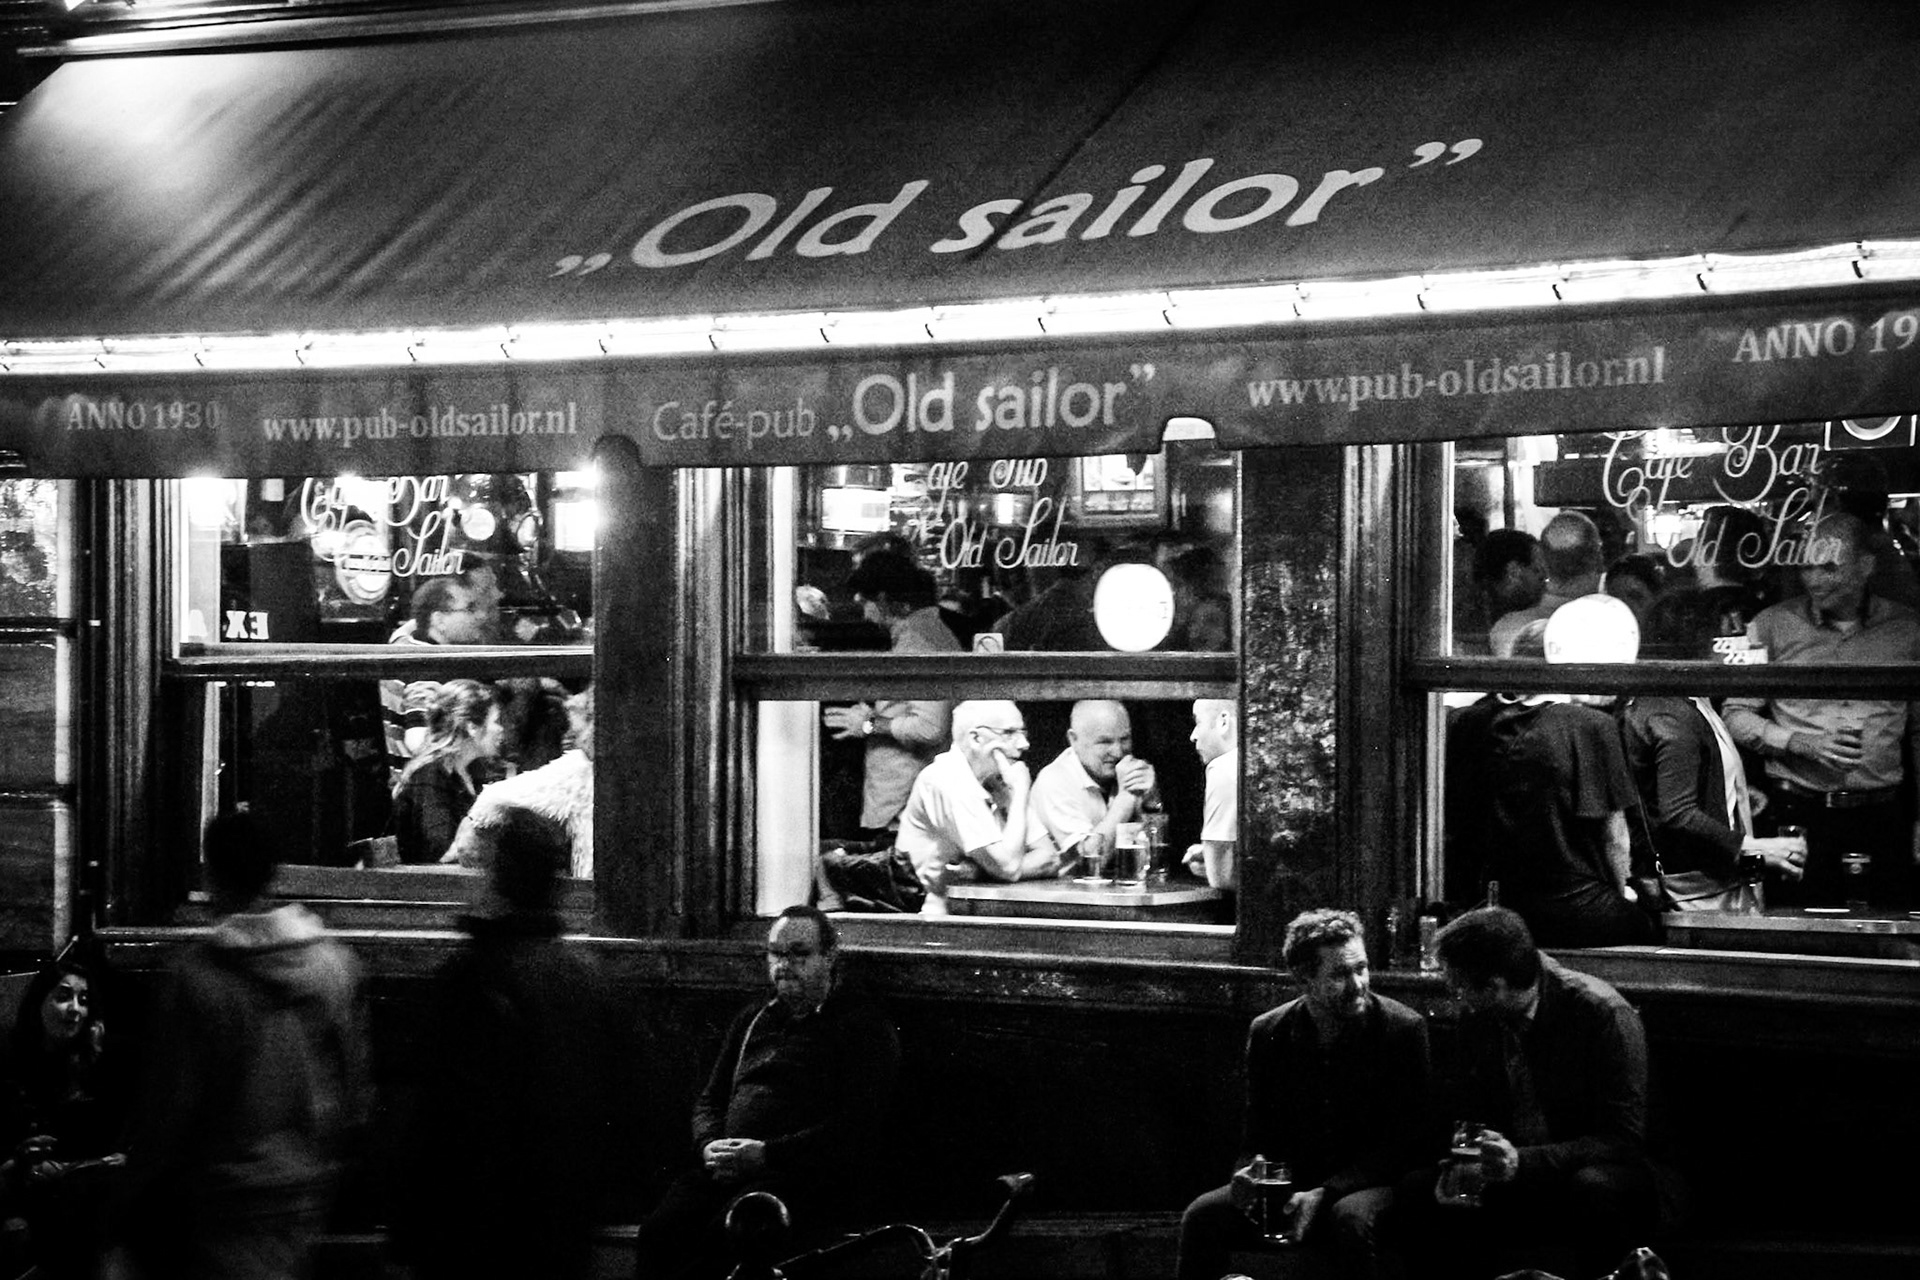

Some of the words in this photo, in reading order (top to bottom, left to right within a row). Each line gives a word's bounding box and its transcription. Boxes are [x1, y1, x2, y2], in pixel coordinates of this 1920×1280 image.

[1731, 319, 1856, 363] ANNO
[1246, 346, 1667, 409] www.pub-oldsailor.nl
[66, 402, 147, 430] ANNO
[153, 401, 221, 430] 1930
[262, 403, 578, 447] www.pub-oldsailor.nl
[653, 401, 817, 448] Café-pub
[392, 511, 465, 577] Sailor
[941, 518, 988, 569] Old
[995, 496, 1080, 569] Sailor
[1736, 487, 1843, 568] Sailor
